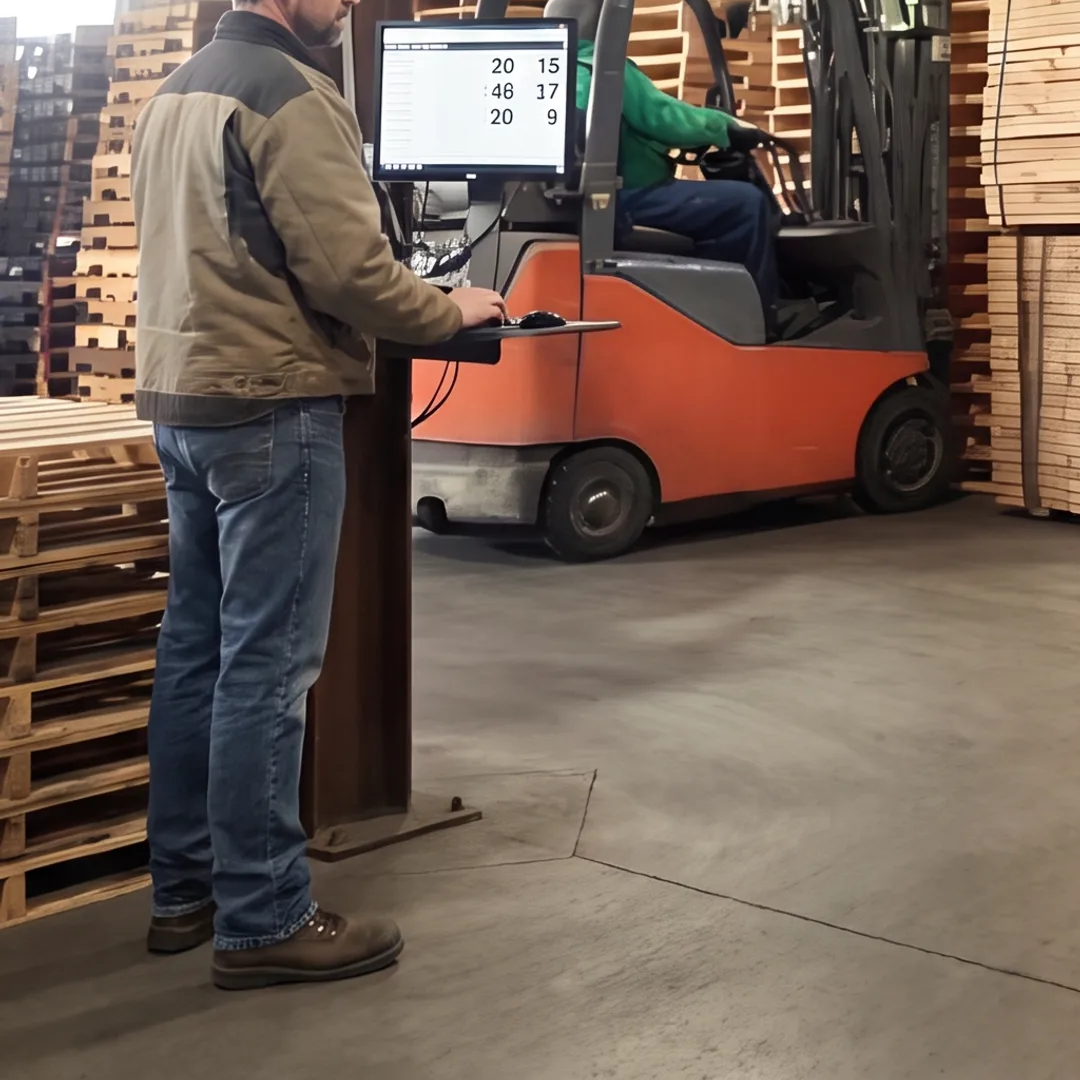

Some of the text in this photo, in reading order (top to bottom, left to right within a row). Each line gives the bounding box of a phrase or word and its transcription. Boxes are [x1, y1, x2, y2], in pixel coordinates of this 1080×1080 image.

[491, 57, 560, 74] 20 15
[490, 108, 558, 126] 20 9
